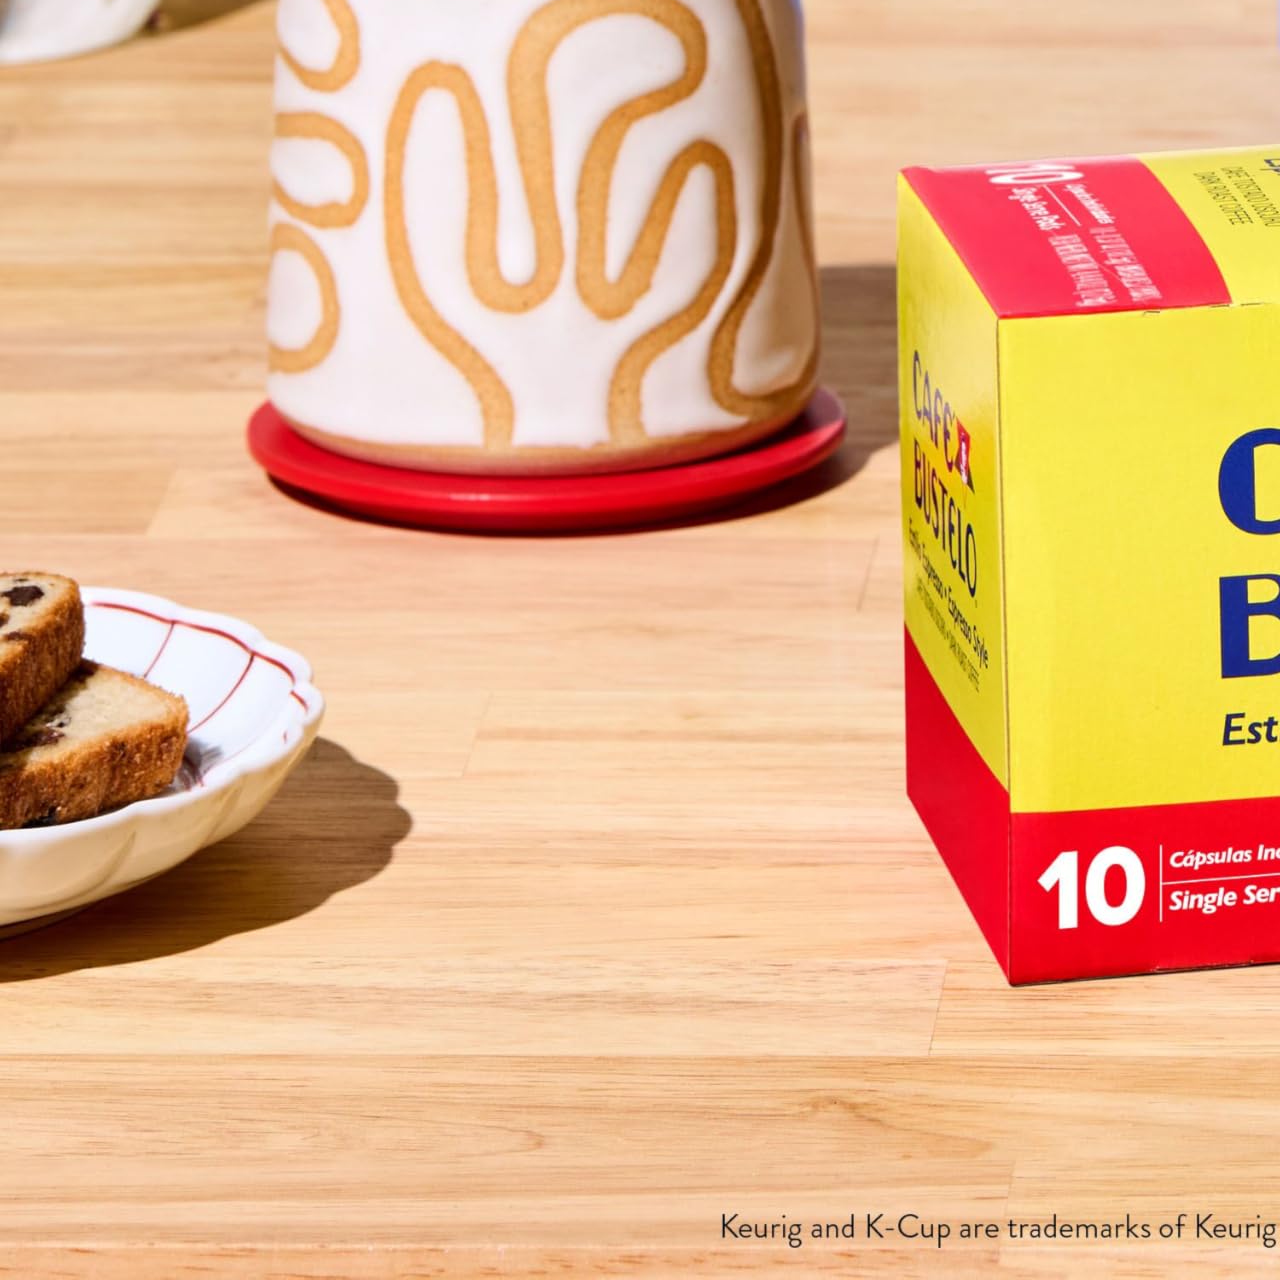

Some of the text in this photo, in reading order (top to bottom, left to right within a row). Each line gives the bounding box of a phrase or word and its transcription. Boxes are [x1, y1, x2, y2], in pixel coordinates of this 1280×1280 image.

[912, 349, 956, 473] CAFÉ
[913, 437, 978, 599] BUSTELO
[1037, 845, 1146, 930] 10
[1169, 846, 1252, 870] Cápsulas
[1168, 889, 1237, 914] Single
